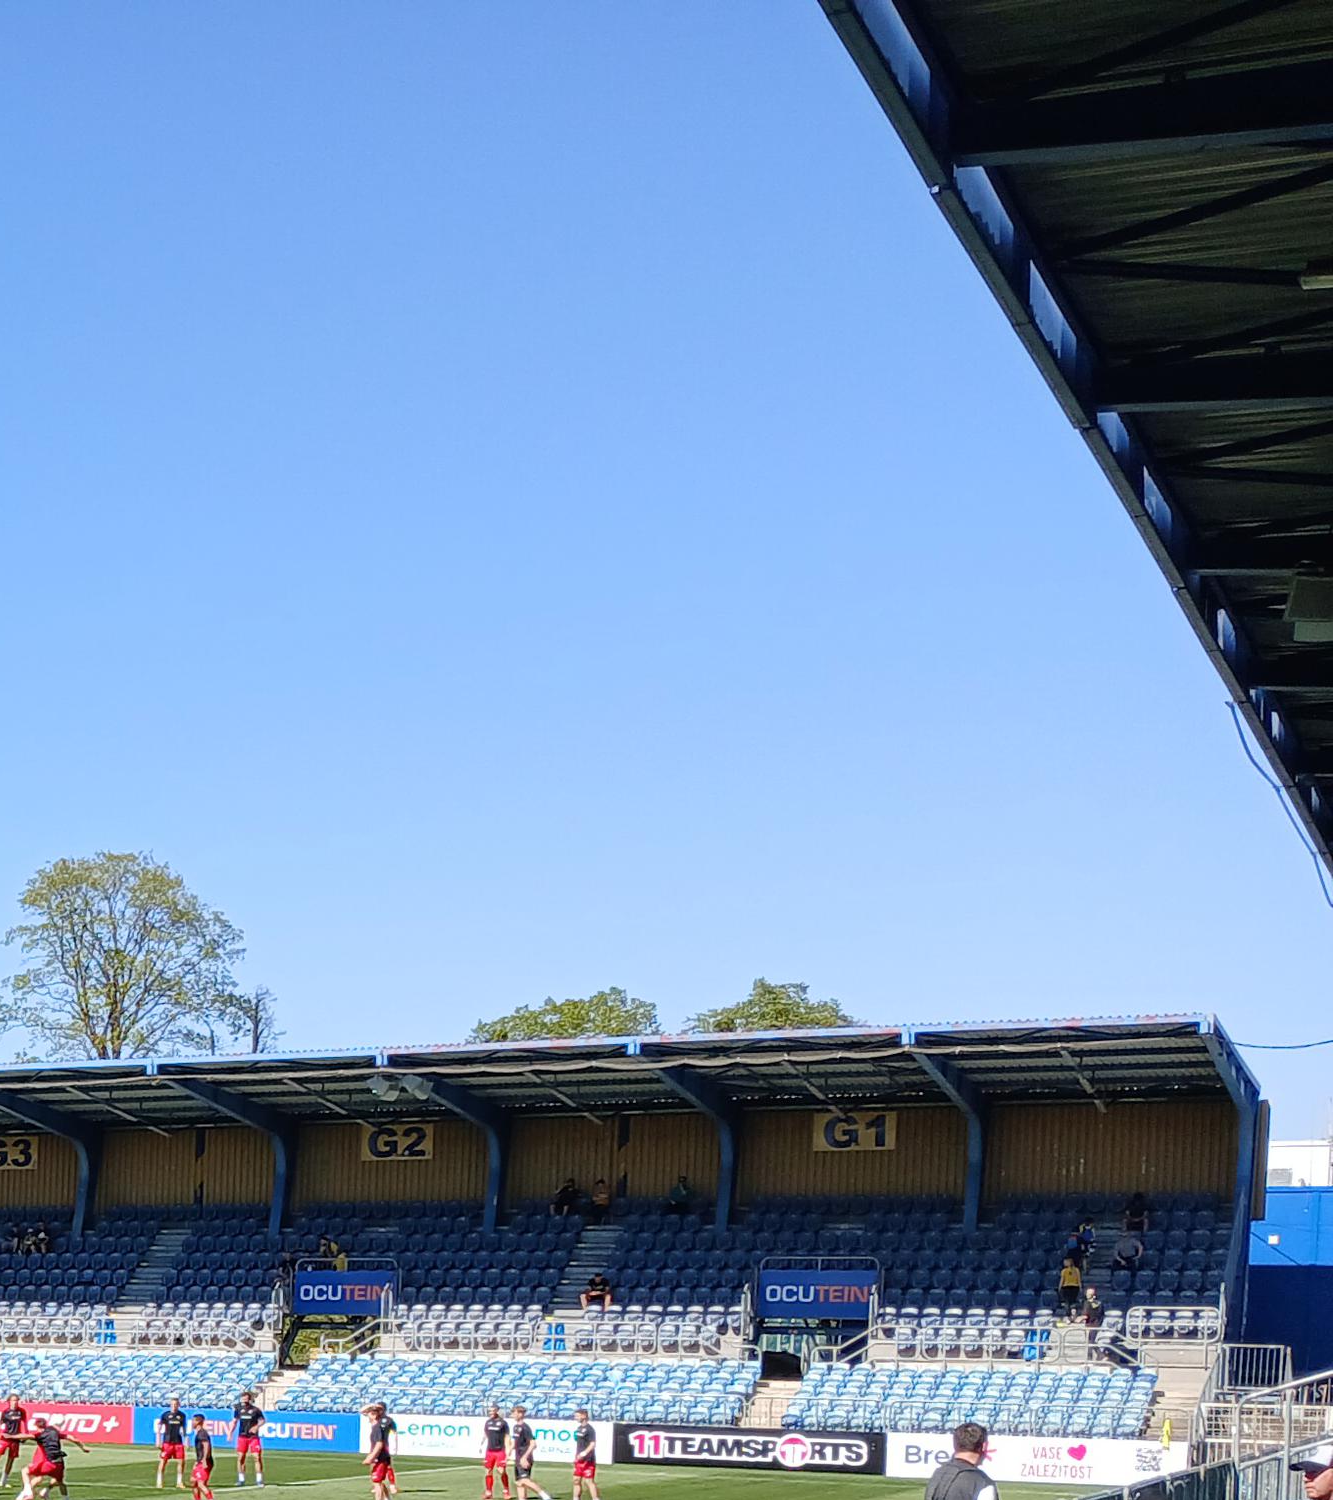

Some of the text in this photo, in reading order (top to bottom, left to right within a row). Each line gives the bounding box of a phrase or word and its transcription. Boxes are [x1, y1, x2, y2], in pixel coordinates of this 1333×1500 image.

[368, 1126, 427, 1158] G2
[823, 1114, 886, 1148] G1
[765, 1285, 870, 1303] OCUTEIN
[261, 1421, 335, 1440] CUTEIN
